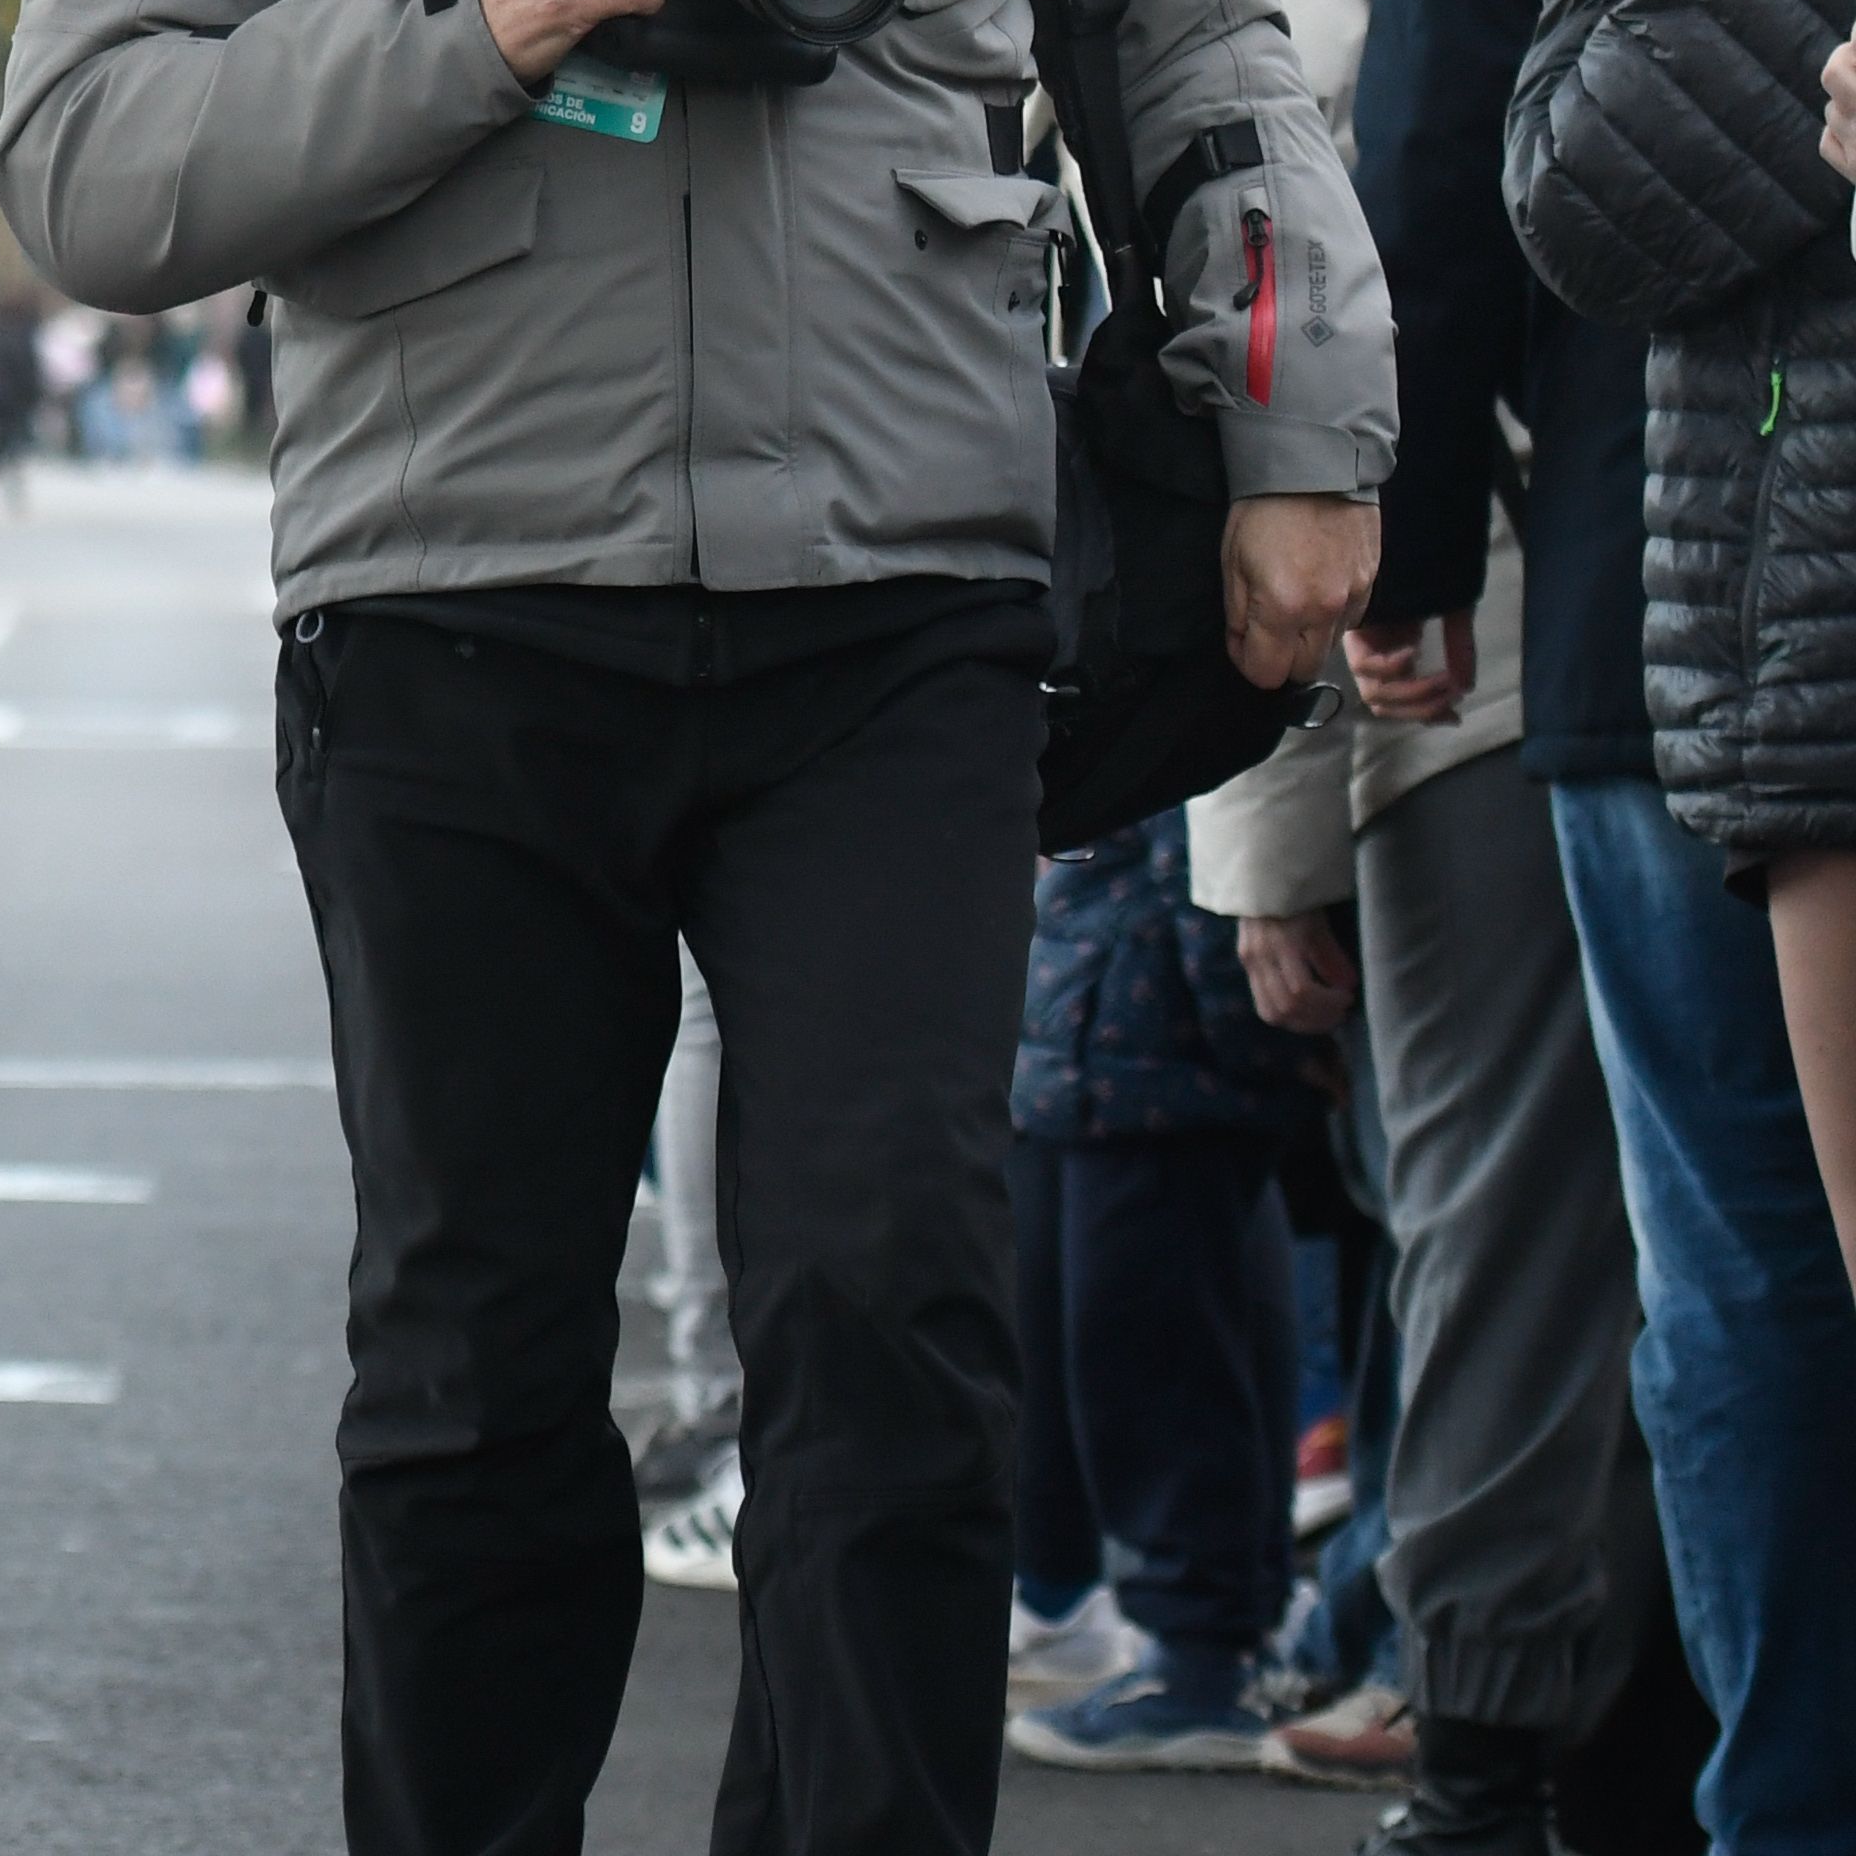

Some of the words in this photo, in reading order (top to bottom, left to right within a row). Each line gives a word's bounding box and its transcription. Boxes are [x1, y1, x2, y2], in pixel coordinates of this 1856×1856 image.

[534, 103, 597, 125] NICACIÓN
[566, 96, 584, 110] DE
[629, 111, 647, 134] 9
[1307, 240, 1327, 313] GORE-TEX
